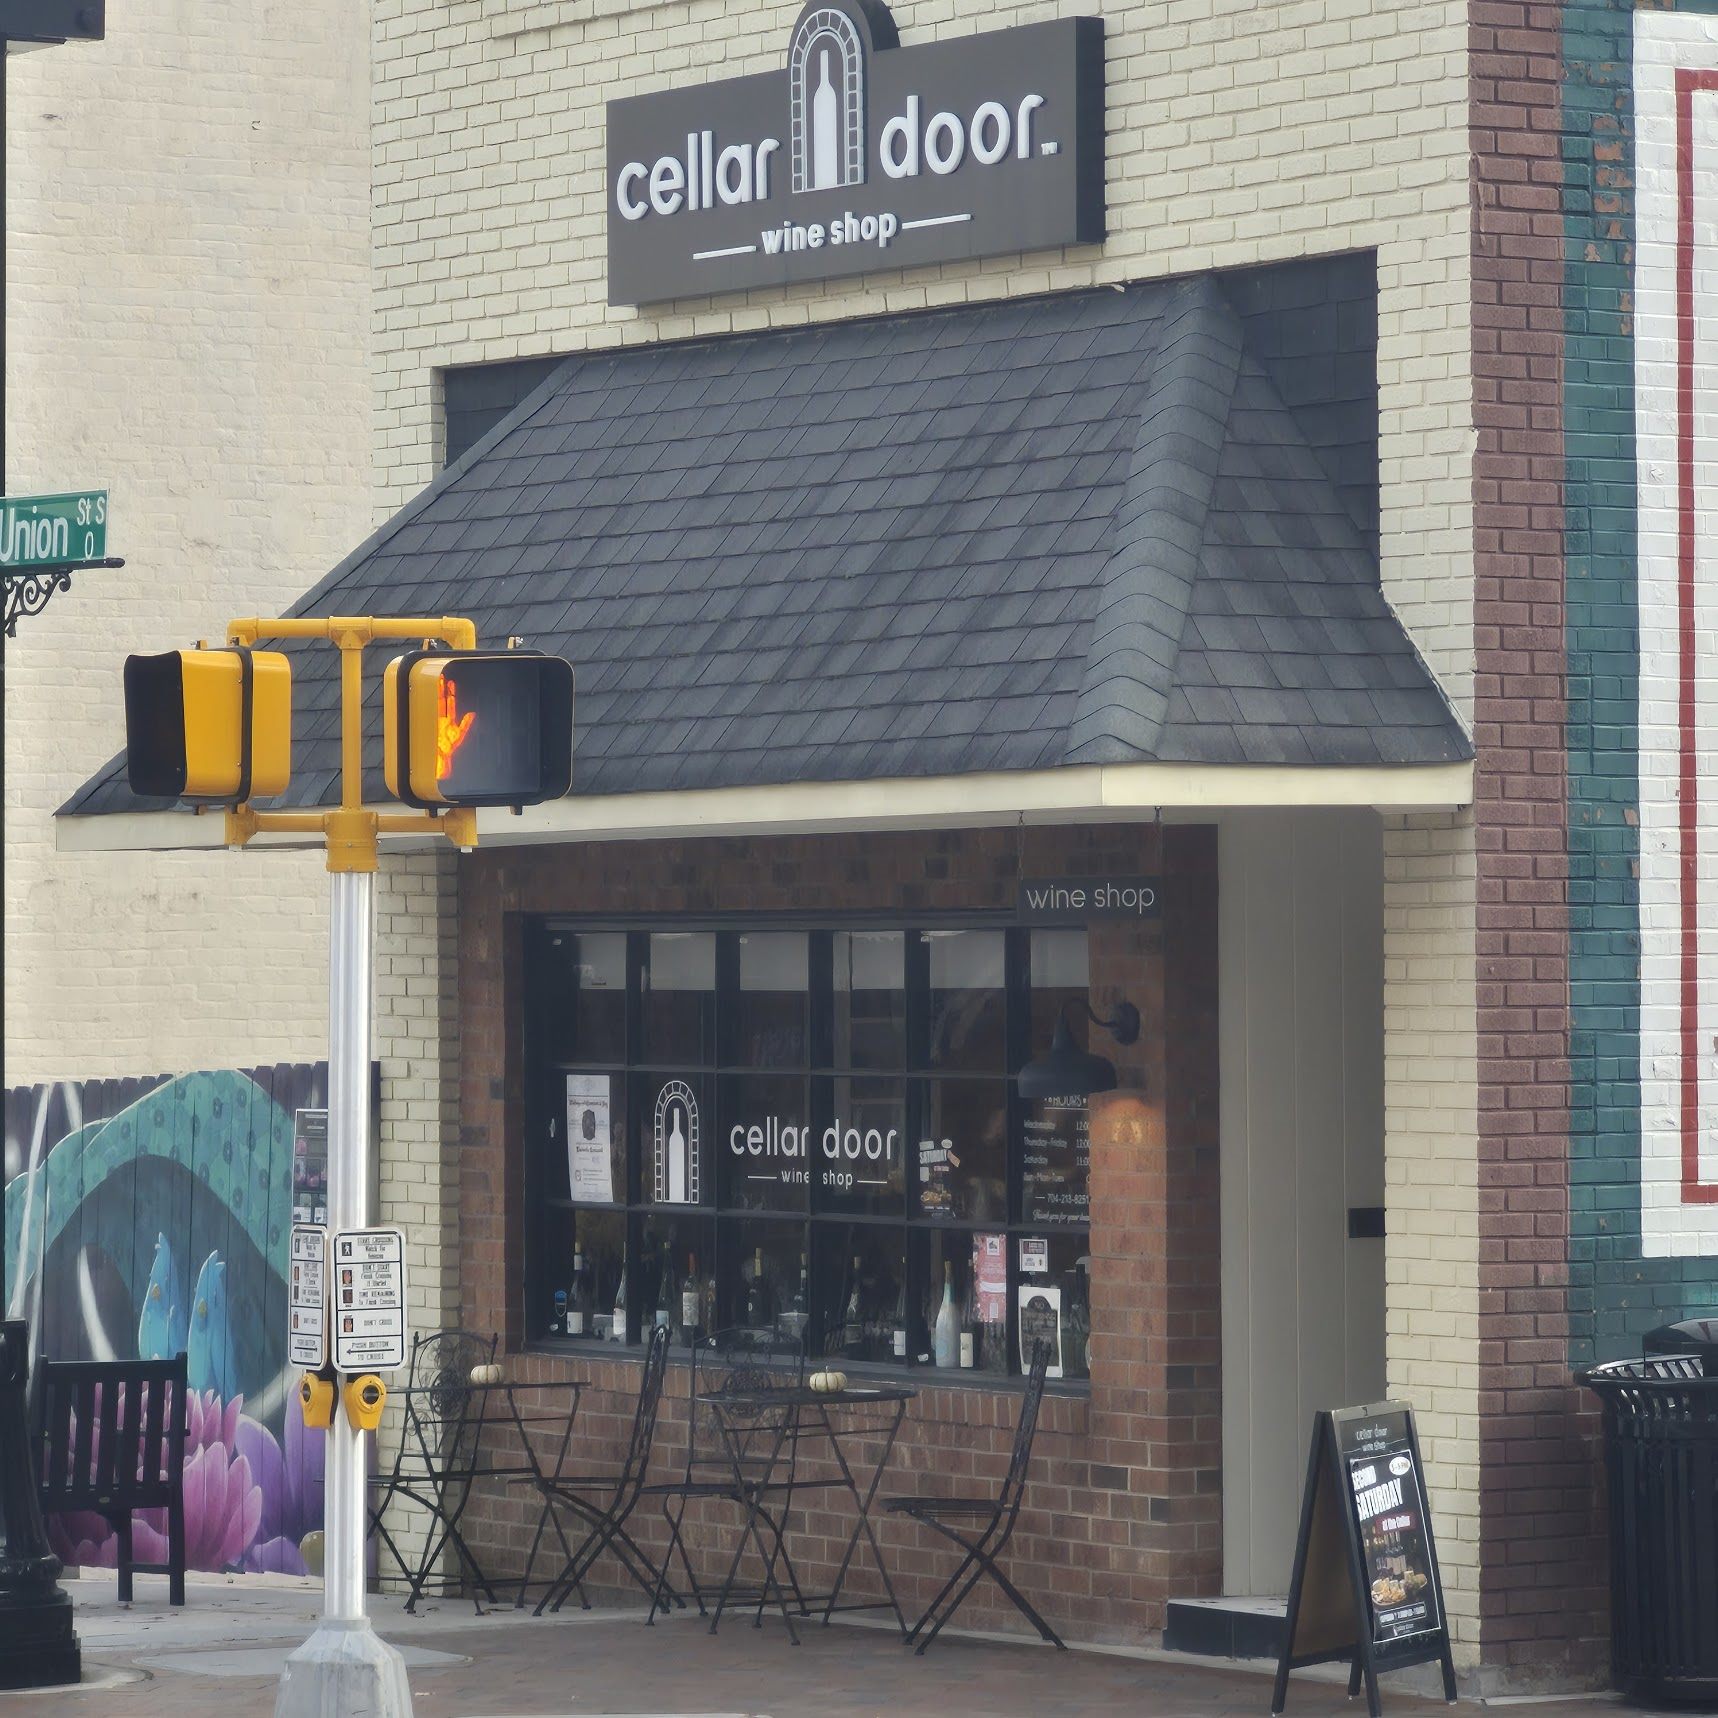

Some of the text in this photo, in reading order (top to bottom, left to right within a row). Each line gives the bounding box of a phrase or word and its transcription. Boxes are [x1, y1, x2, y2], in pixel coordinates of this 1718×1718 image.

[616, 130, 780, 220] cellar
[761, 211, 898, 255] wine shop
[0, 497, 105, 562] Union St S
[1026, 882, 1155, 914] wine shop
[730, 1116, 897, 1160] cellar door
[781, 1168, 853, 1190] wine shop
[1355, 1477, 1404, 1521] SATURDAY
